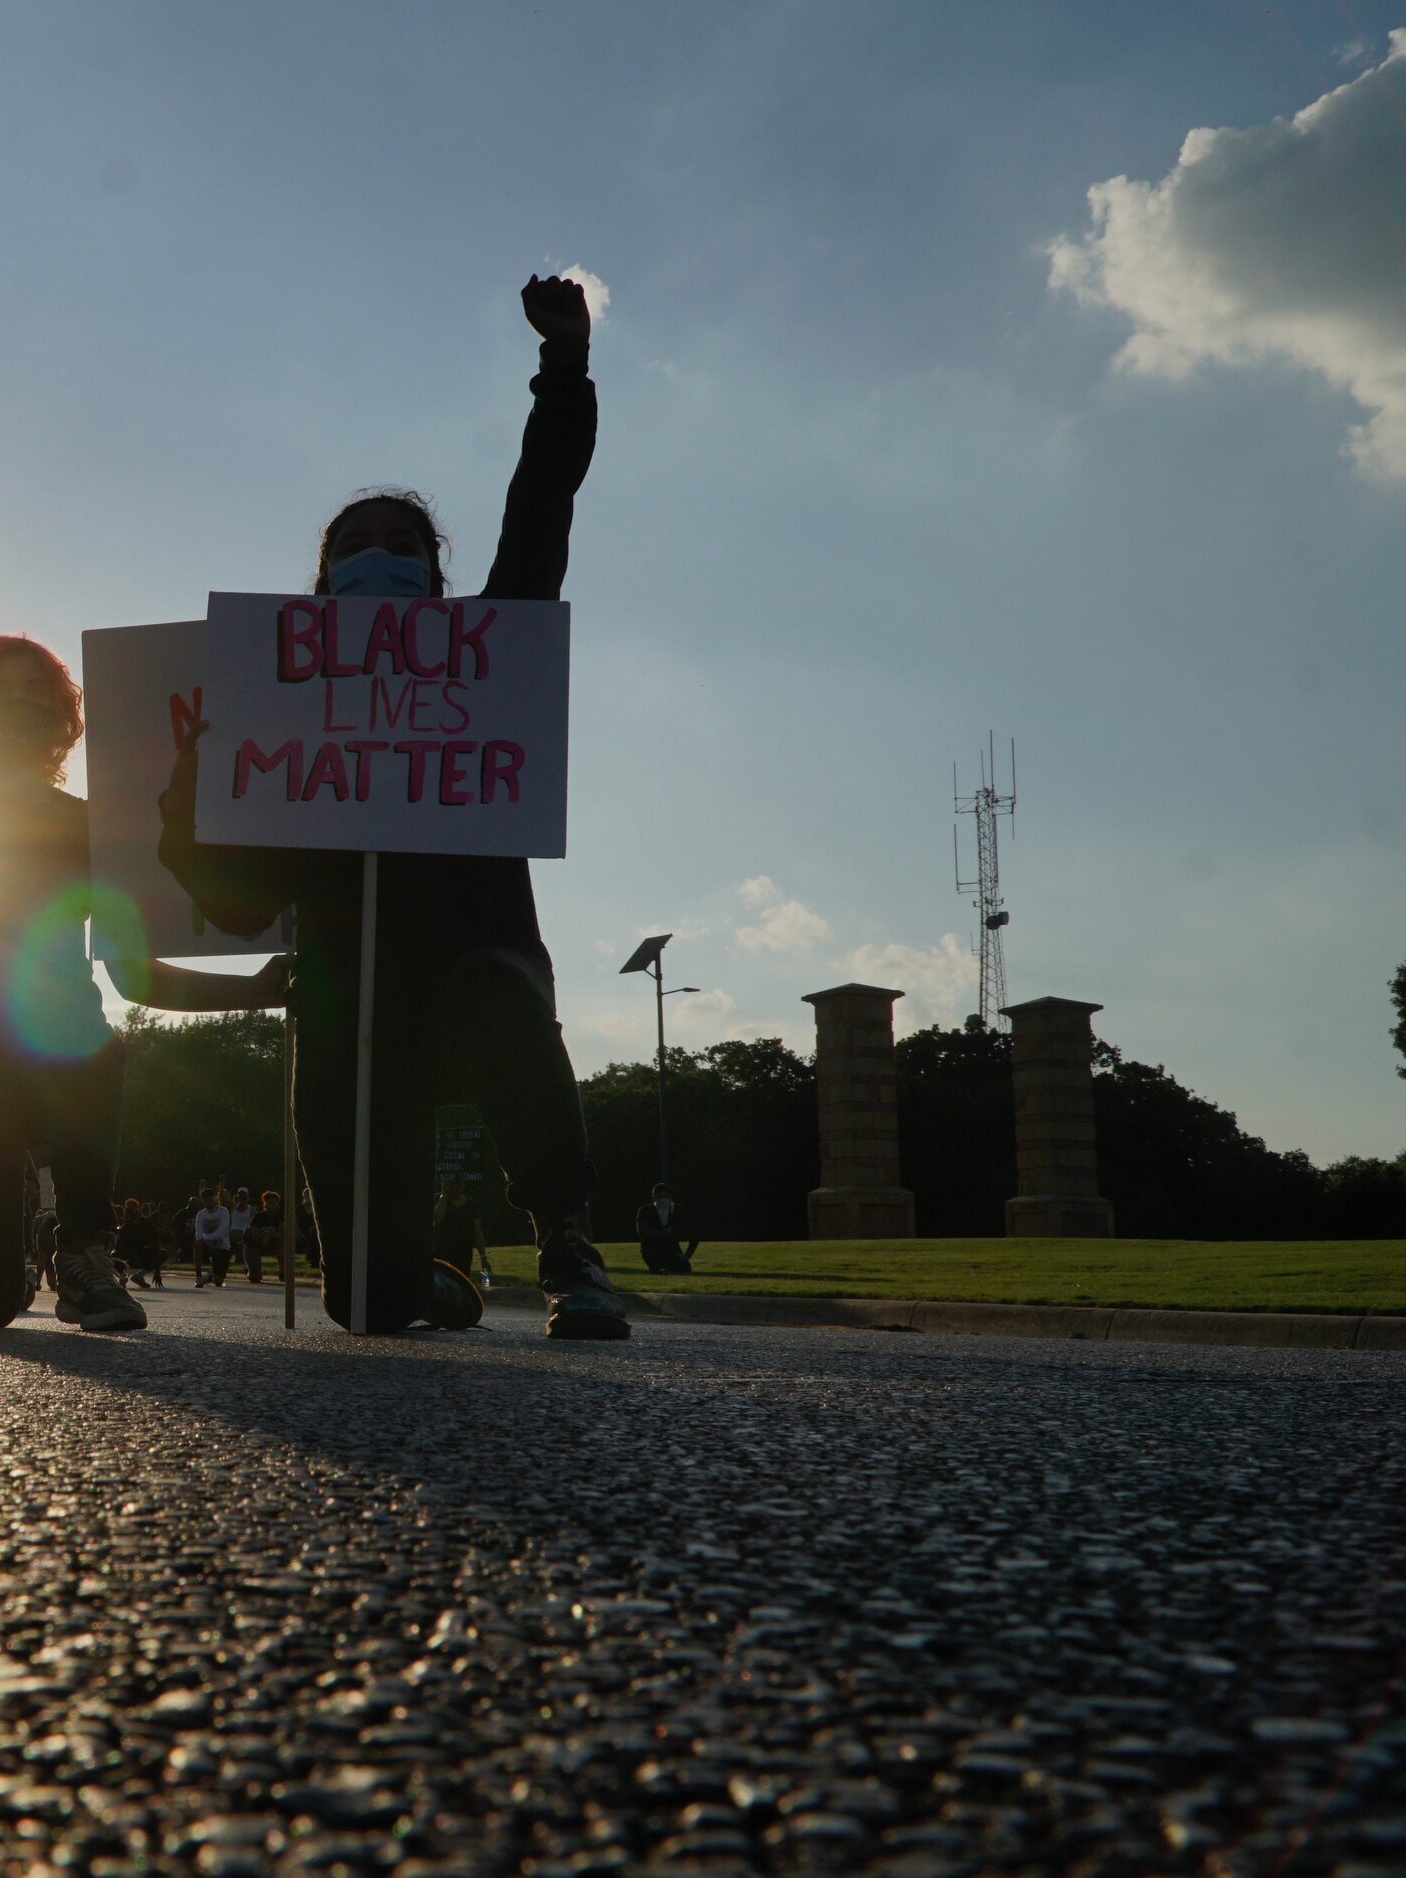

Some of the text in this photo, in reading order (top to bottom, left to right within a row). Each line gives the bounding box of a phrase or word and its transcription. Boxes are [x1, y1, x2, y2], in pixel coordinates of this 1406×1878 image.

[277, 598, 498, 683] BLACK
[323, 676, 471, 735] LIVES
[233, 738, 526, 806] MATTER
